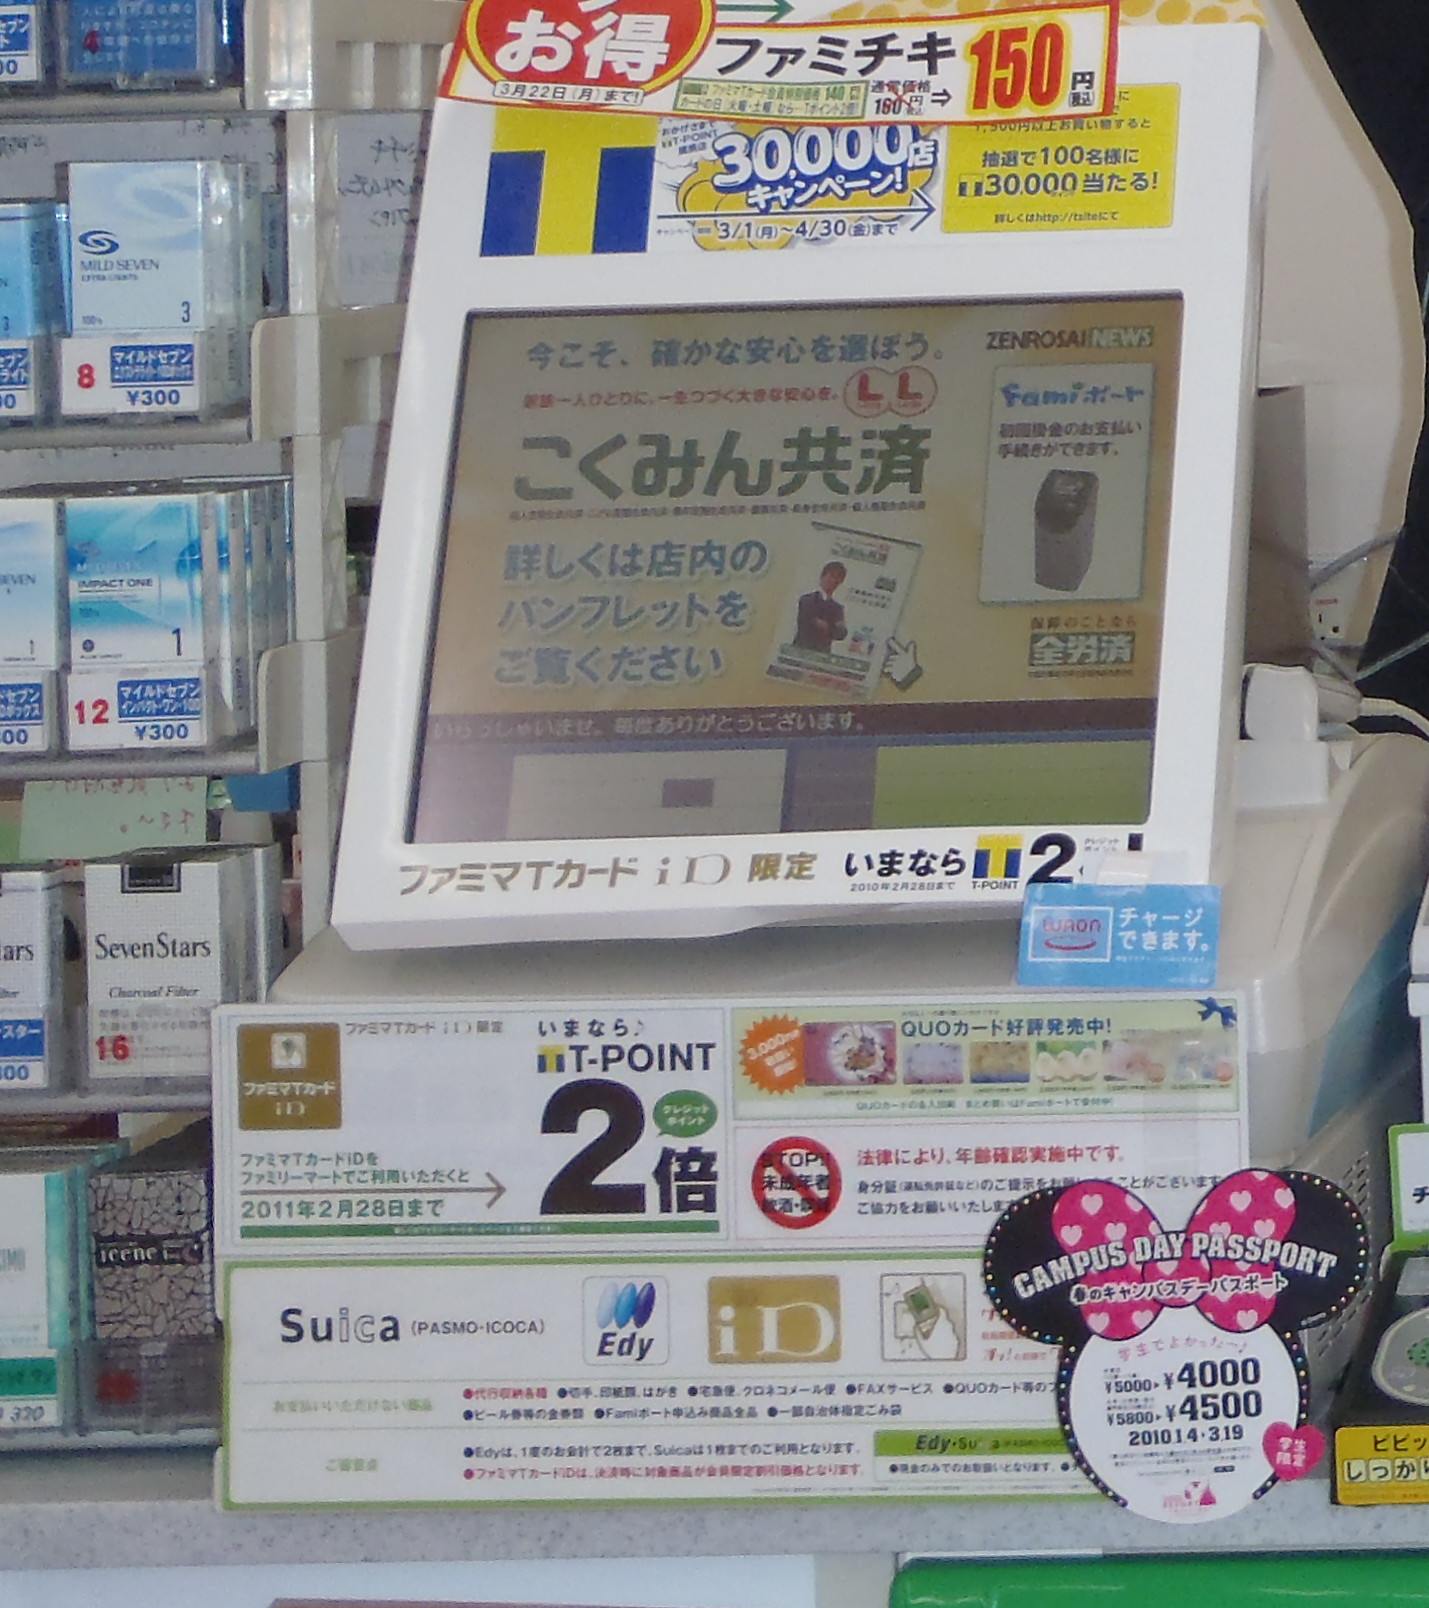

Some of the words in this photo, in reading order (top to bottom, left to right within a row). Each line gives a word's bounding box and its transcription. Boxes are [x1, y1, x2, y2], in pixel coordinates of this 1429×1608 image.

[495, 8, 670, 81] お得
[716, 31, 957, 78] ファミチキ
[970, 23, 1065, 110] 150
[747, 166, 903, 210] キャンペーン!
[117, 259, 159, 271] SEVEN
[986, 331, 1088, 351] ZENROSAI
[1090, 327, 1153, 347] NEWS
[77, 363, 96, 389] 8
[127, 390, 180, 407] ¥300
[514, 424, 932, 501] こくみん共済
[503, 540, 767, 582] 詳しくは店内の
[498, 593, 749, 631] パンフレットを
[494, 645, 724, 684] ご覧ください
[1032, 635, 1134, 666] 全労済
[74, 699, 110, 725] 12
[134, 724, 189, 740] ¥300
[400, 856, 638, 896] ファミマTカード
[655, 853, 731, 886] iD
[748, 852, 817, 882] 限定
[845, 848, 966, 878] いまなら
[1118, 907, 1202, 926] チャージ
[1118, 930, 1210, 952] できます。
[95, 1035, 131, 1062] 16
[570, 1043, 716, 1072] T-POINT
[540, 1078, 646, 1215] 2
[652, 1146, 718, 1214] 倍
[240, 1167, 470, 1185] ファミリーマートでご利用いただくと
[241, 1199, 445, 1218] 2011年2月28日まで
[1012, 1241, 1127, 1299] CAMPUS
[1134, 1230, 1189, 1262] DAY
[1192, 1232, 1338, 1279] PASSPORT
[1071, 1273, 1289, 1304] 春のキャンパスデーパスポート
[280, 1307, 401, 1344] Suica
[716, 1301, 836, 1358] iD
[596, 1331, 654, 1362] Edy
[1163, 1357, 1261, 1390] ¥4000
[1165, 1390, 1263, 1422] ¥4500
